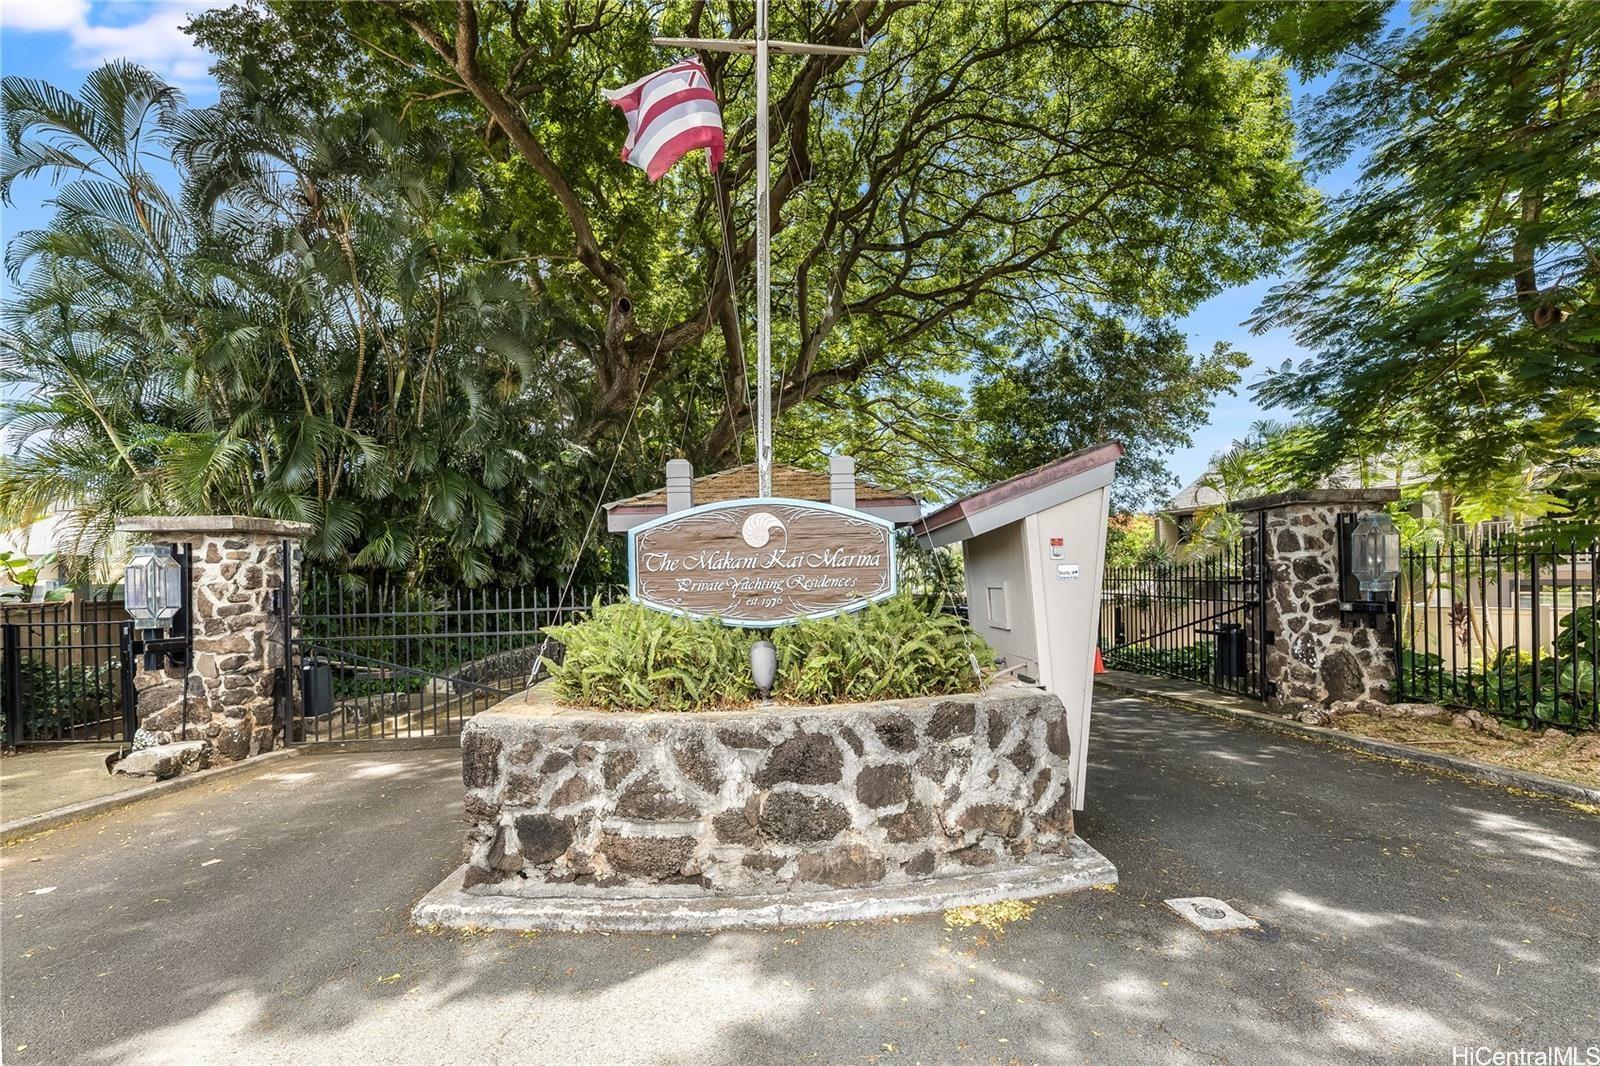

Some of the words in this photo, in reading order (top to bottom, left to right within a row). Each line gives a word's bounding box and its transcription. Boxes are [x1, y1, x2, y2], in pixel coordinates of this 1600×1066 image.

[642, 552, 679, 572] The
[682, 550, 759, 570] Makani
[759, 549, 805, 569] Kai
[806, 548, 881, 568] Marina
[675, 578, 725, 592] Private
[726, 577, 784, 598] Yachting
[786, 574, 858, 591] Residences
